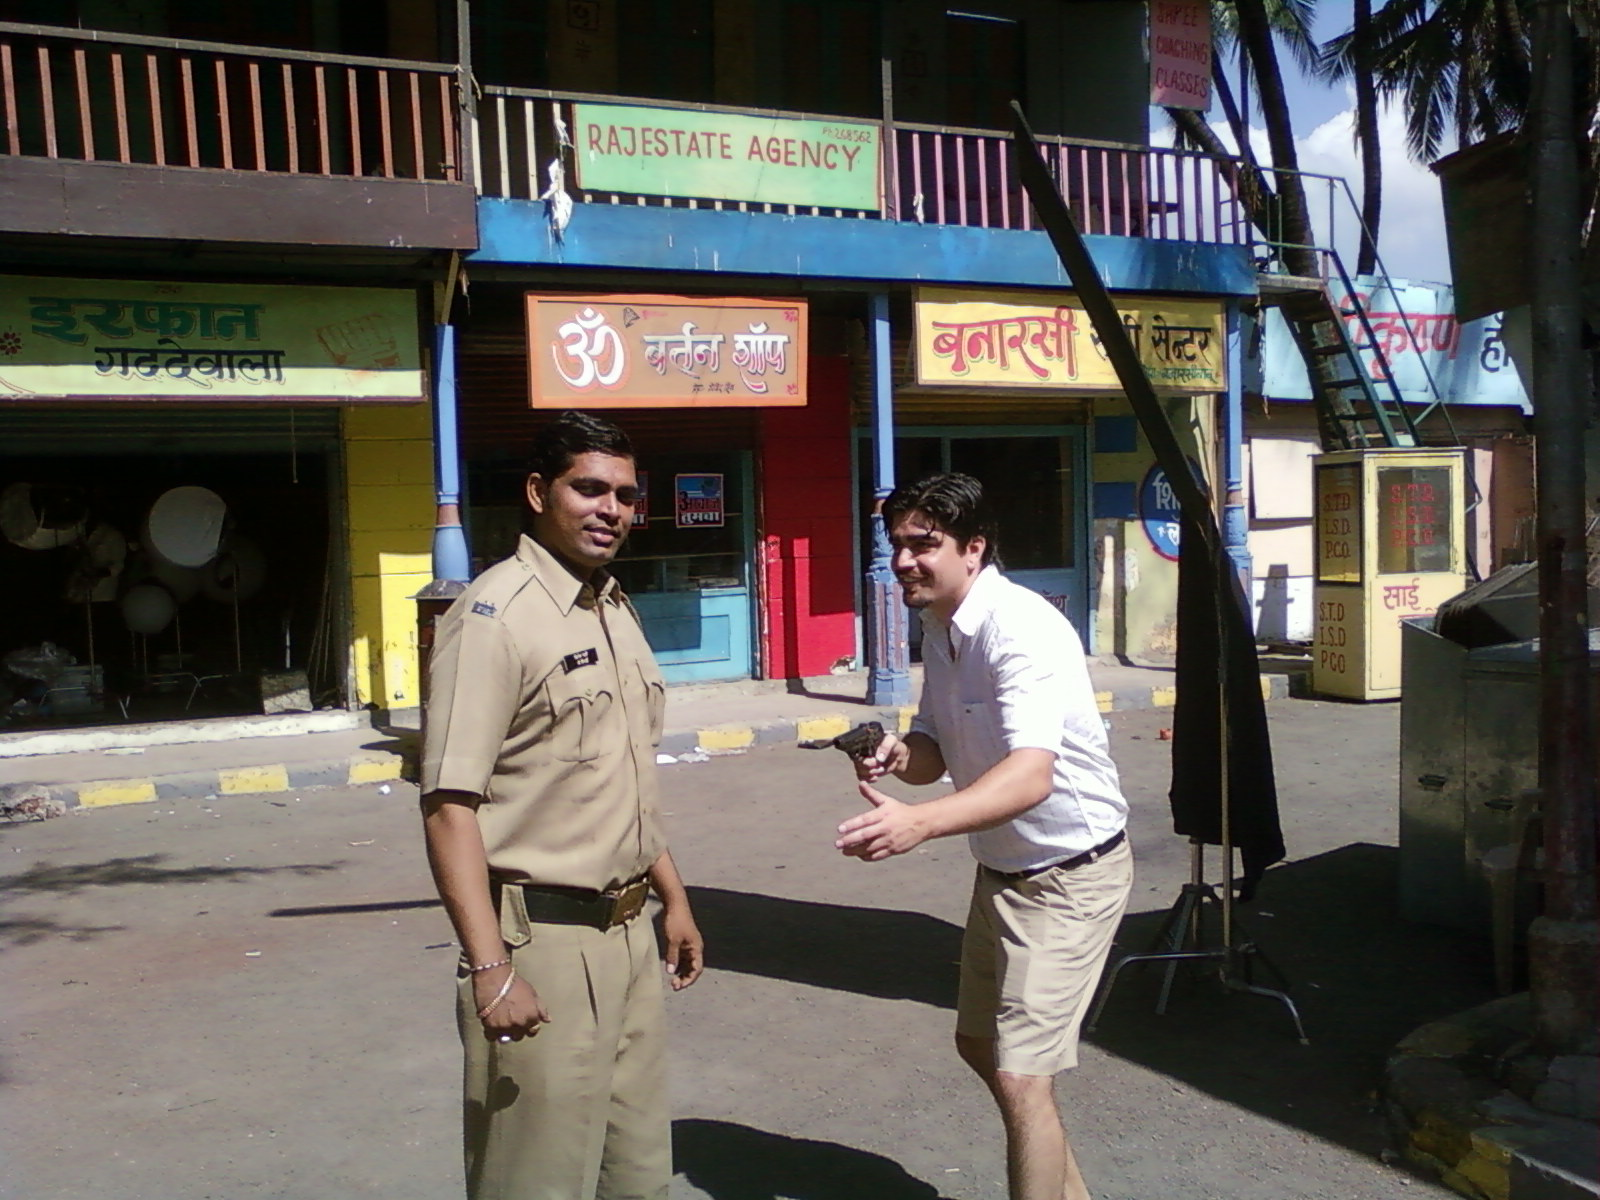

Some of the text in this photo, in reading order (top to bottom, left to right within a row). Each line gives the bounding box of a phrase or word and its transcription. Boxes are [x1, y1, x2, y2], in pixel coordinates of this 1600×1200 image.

[1156, 36, 1208, 65] COACHING
[1156, 67, 1208, 98] CLASSES
[747, 135, 862, 172] AGENCY
[29, 297, 265, 346] इरफान
[643, 322, 726, 379] बर्तन
[732, 322, 791, 393] शॉप
[932, 304, 1078, 379] बनारसी
[1383, 577, 1421, 610] साई
